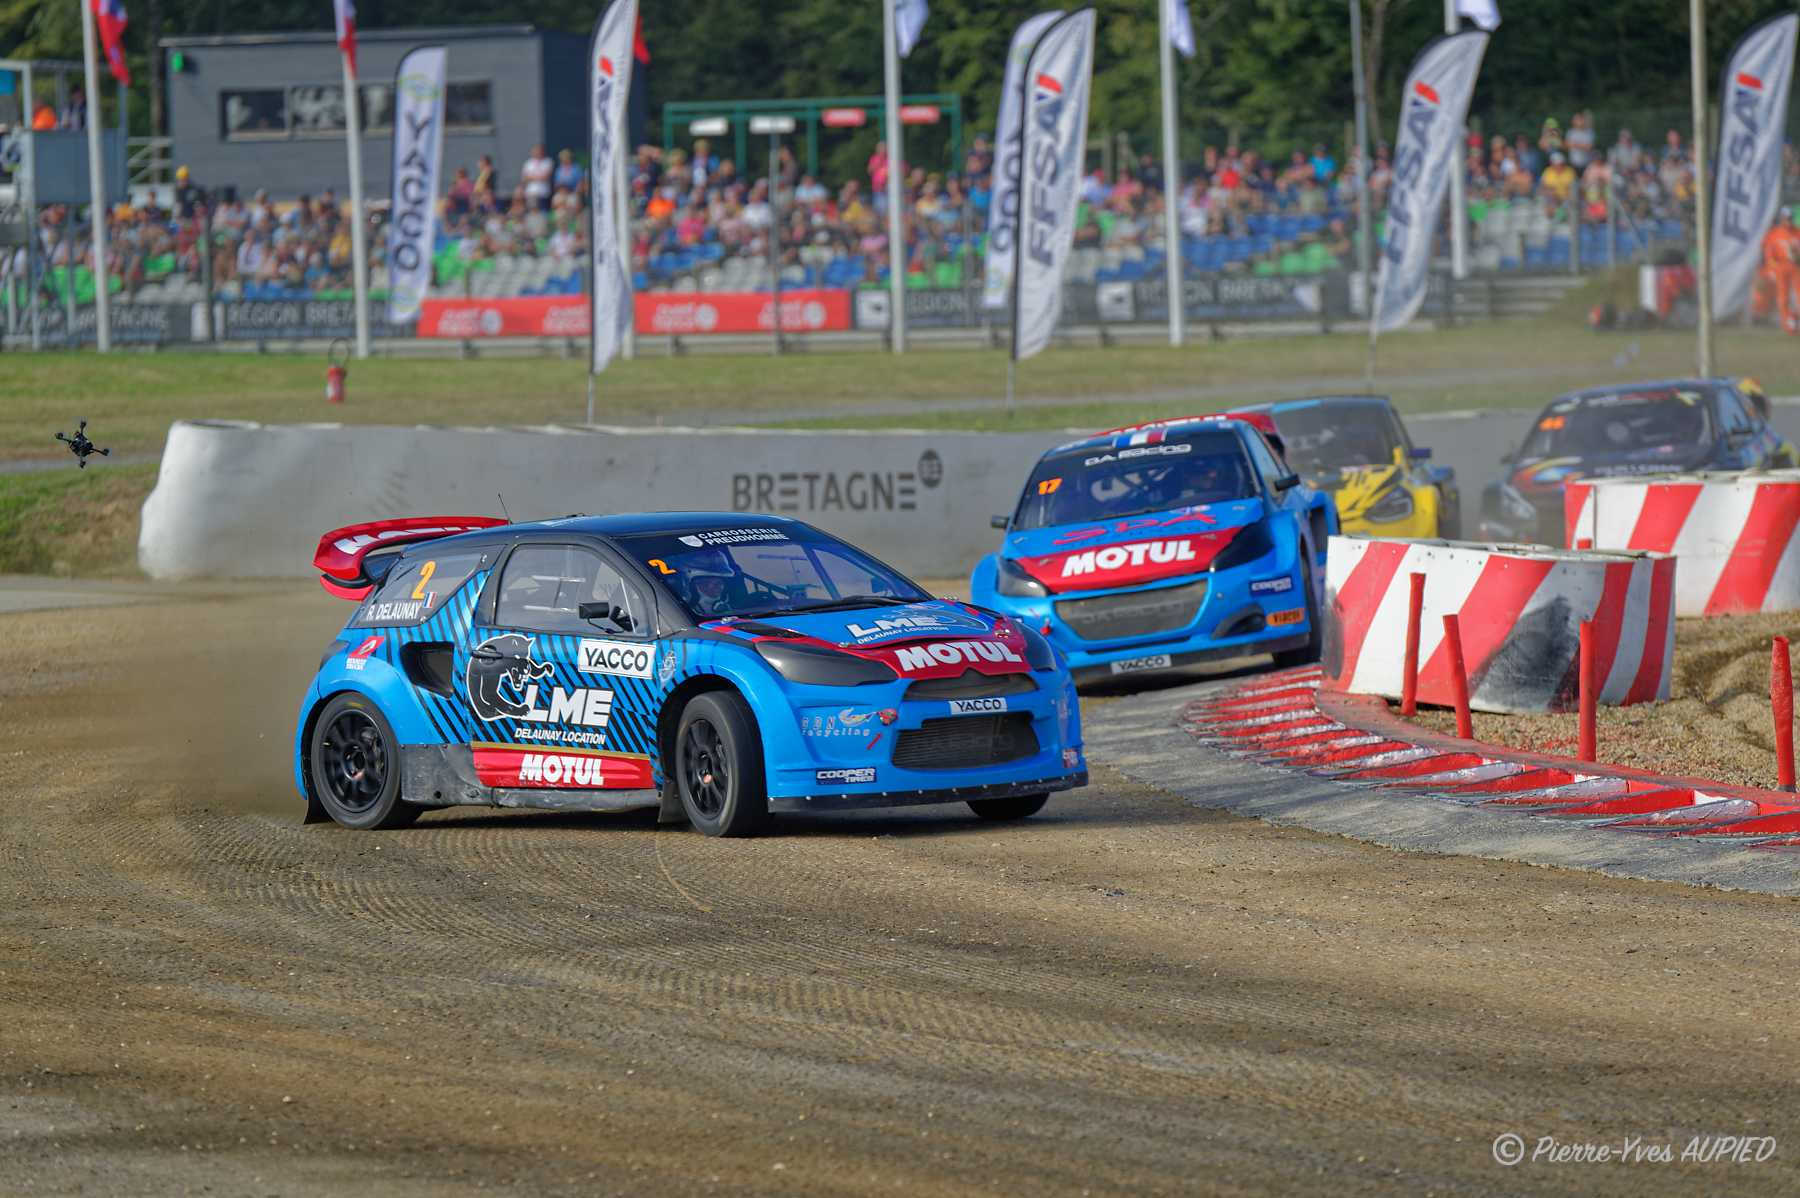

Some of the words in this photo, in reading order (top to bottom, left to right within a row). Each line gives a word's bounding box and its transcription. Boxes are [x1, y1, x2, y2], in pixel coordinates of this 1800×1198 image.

[990, 78, 1021, 253] CCO
[1722, 89, 1760, 245] FFSA
[395, 109, 432, 272] YACCO
[733, 472, 916, 511] BRETAGNE
[1039, 478, 1062, 495] 17
[698, 528, 781, 539] CARROSSERIE
[705, 533, 790, 545] PREUDHOMME
[648, 559, 677, 574] 2
[1061, 540, 1196, 577] MOTUL
[411, 561, 436, 599] 2
[375, 602, 421, 620] DELAUNAY
[846, 616, 947, 638] LME
[585, 647, 648, 671] YACCO
[894, 641, 1022, 671] MOTUL
[1119, 656, 1165, 670] YACCO
[522, 685, 614, 726] LME
[955, 699, 1002, 712] YACCO
[515, 728, 561, 741] DELAUNAY
[561, 731, 606, 744] LOCATION
[519, 754, 604, 785] MOTUL
[817, 768, 875, 779] COOPER
